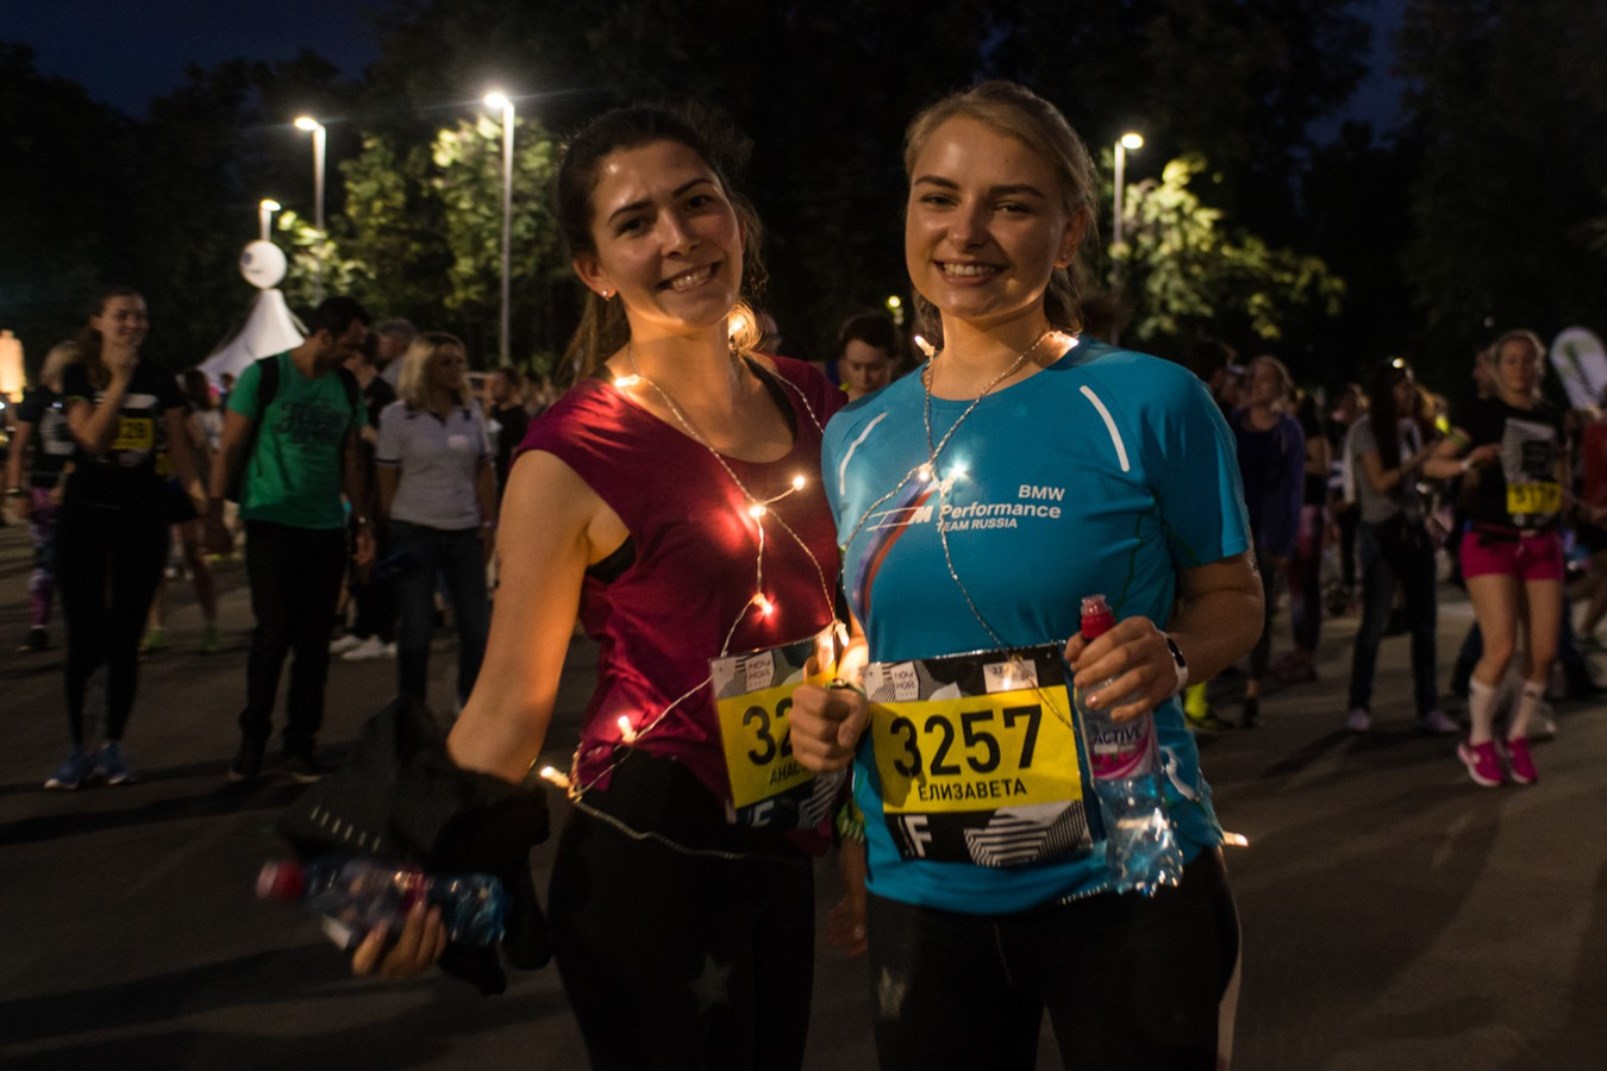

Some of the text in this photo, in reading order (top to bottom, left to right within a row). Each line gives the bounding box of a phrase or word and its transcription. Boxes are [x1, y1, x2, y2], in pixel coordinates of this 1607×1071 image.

[1018, 484, 1066, 501] BMW
[940, 501, 1062, 520] Performance
[936, 517, 1018, 533] TEAM RUSSIA
[890, 704, 1043, 778] 3257
[918, 777, 1028, 801] ЕЛИЗАВЕТА
[904, 814, 933, 859] F
